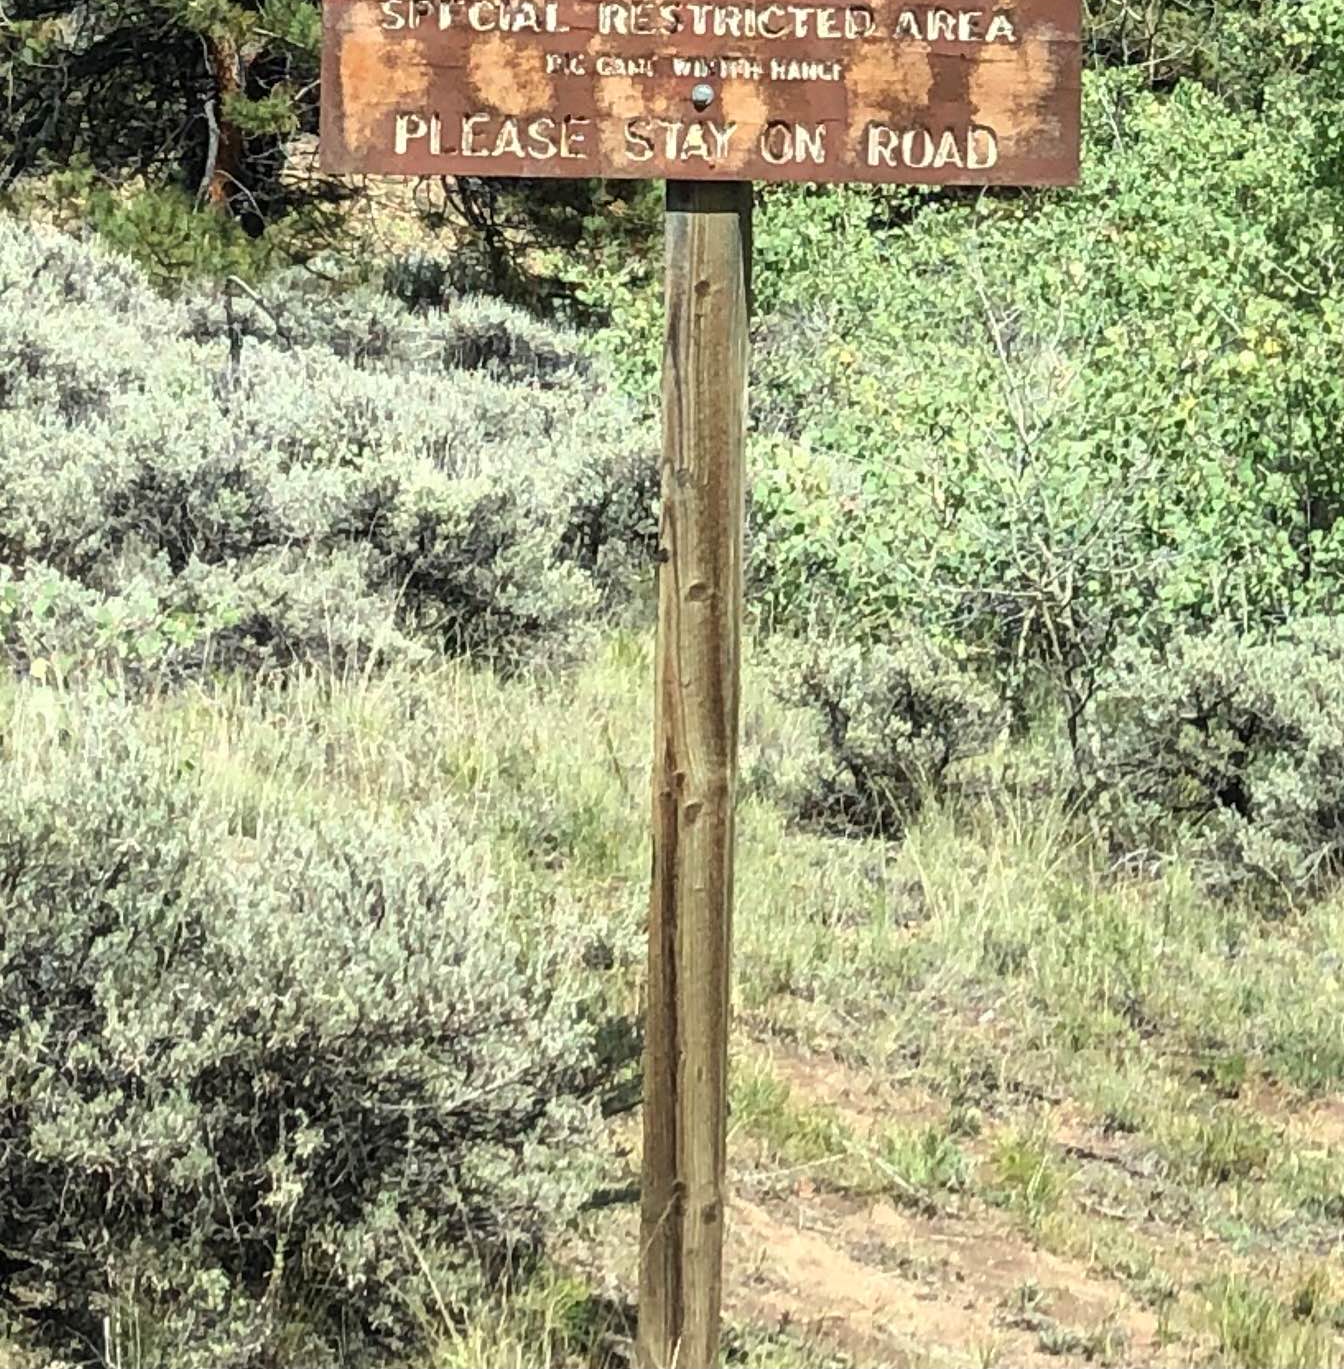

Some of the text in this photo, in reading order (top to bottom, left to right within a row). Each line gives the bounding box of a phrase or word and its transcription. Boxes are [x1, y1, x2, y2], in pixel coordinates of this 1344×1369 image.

[598, 0, 876, 39] RESTRICTED
[894, 5, 1016, 42] AREA
[393, 111, 999, 170] PLEASE STAY ON ROAD
